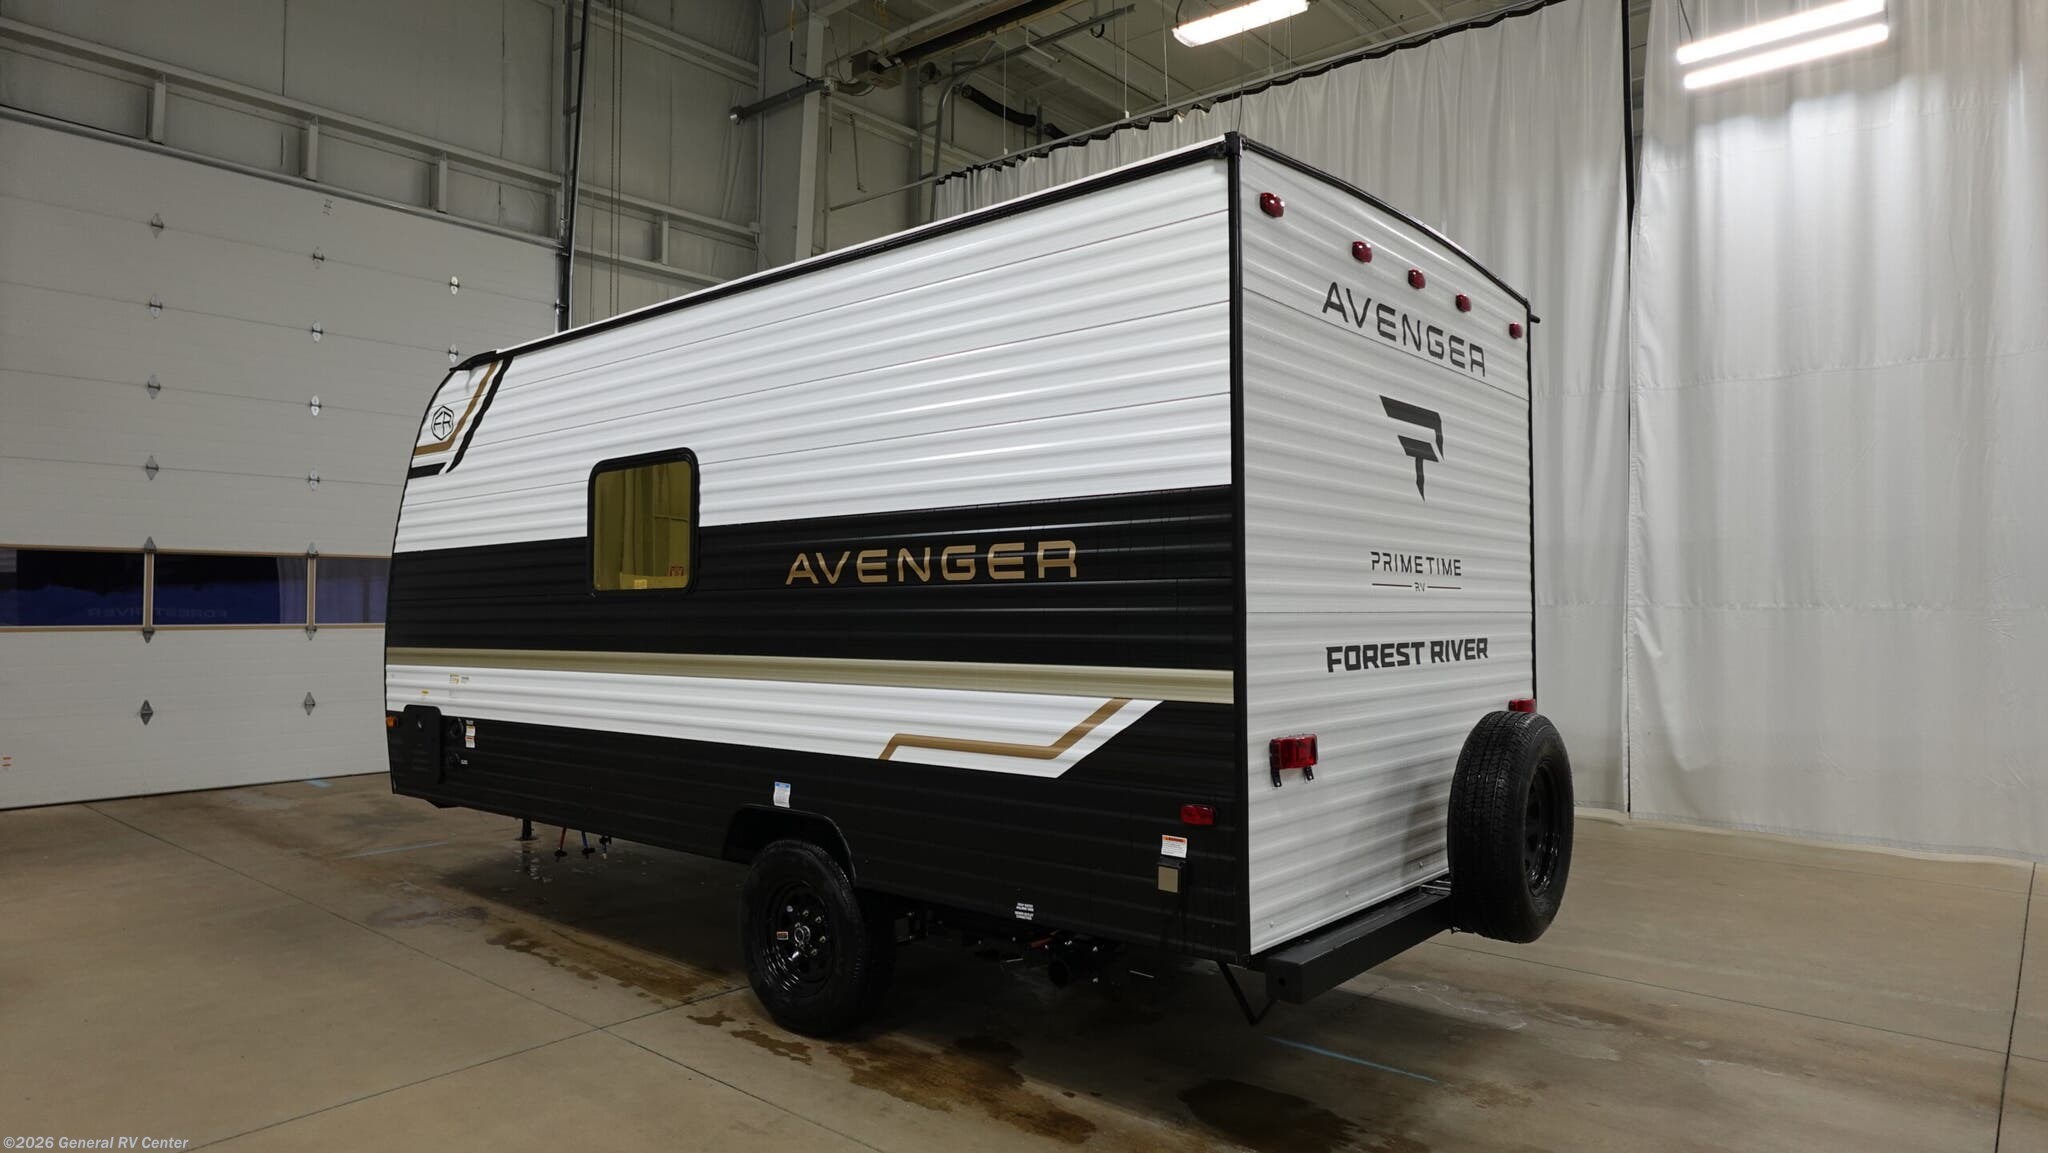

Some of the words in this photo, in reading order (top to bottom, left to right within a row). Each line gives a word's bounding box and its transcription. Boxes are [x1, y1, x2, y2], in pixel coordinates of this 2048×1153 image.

[1322, 281, 1486, 378] AVENGER
[785, 540, 1077, 585] AVENGER
[1414, 582, 1426, 592] RV
[1325, 641, 1425, 673] FOREST
[1430, 637, 1489, 664] RIVER
